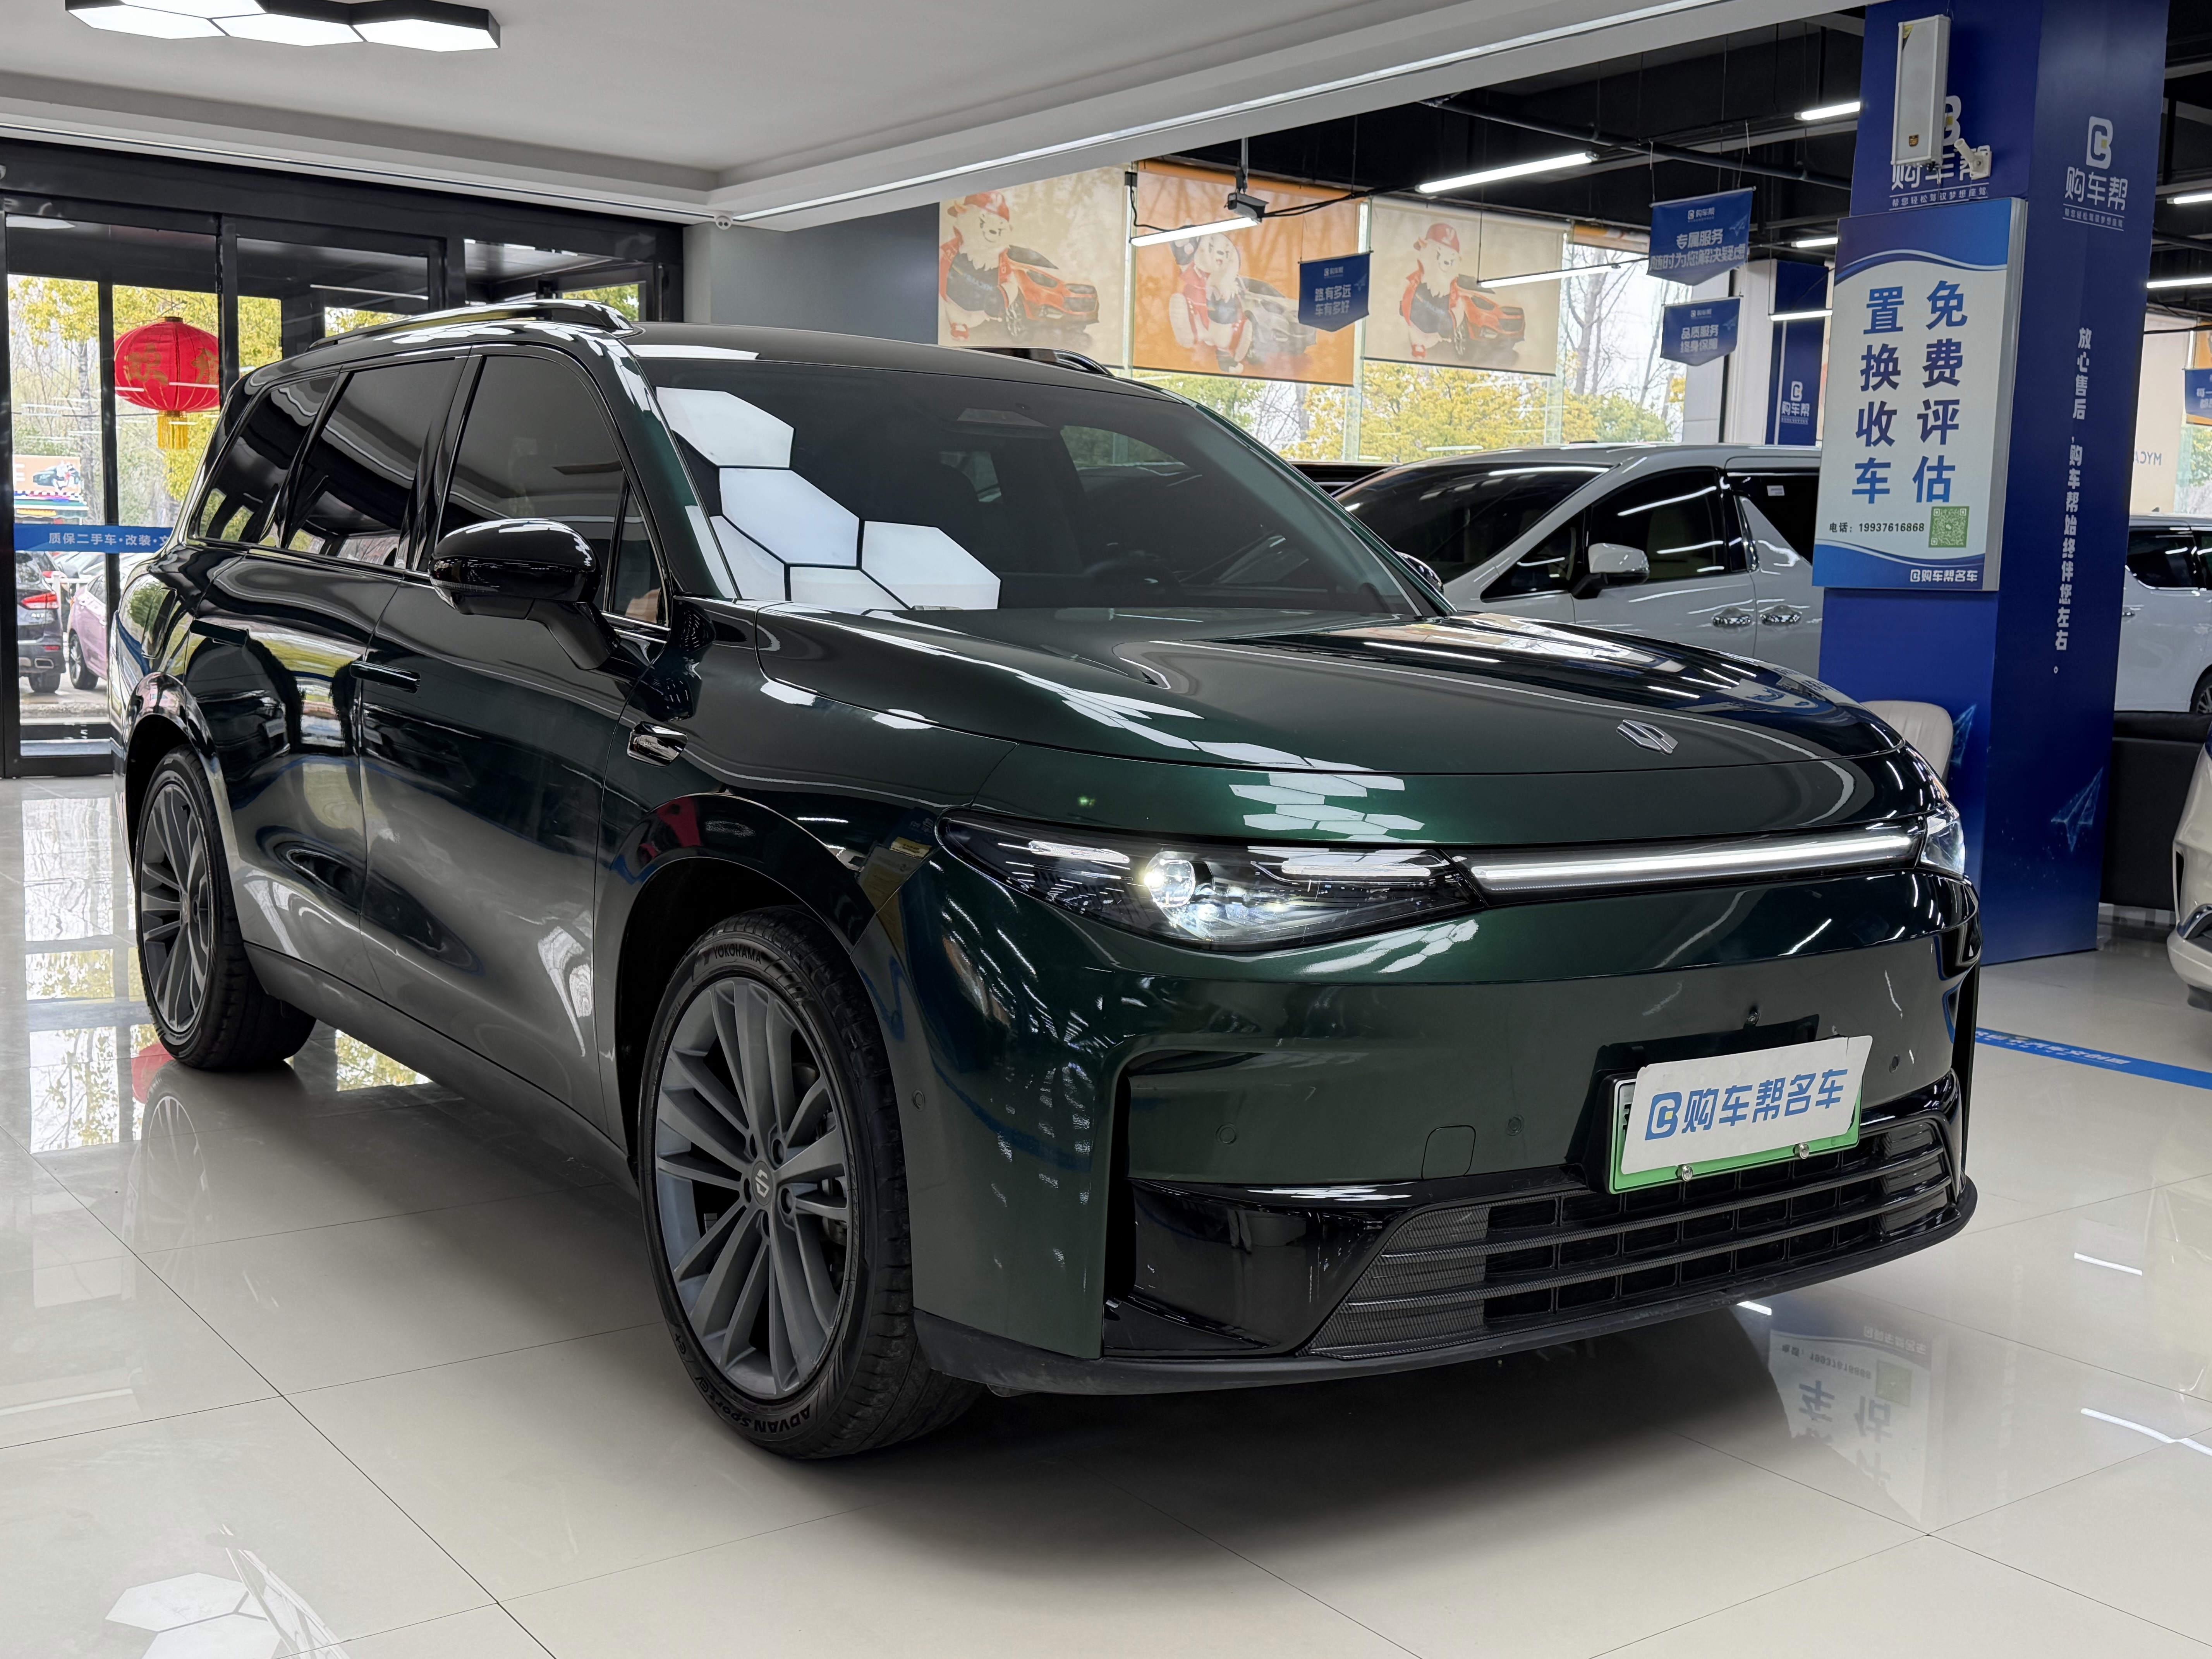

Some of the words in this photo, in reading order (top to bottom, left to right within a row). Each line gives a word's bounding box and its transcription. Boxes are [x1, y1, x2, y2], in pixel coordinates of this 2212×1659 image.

[2064, 166, 2128, 211] 购车帮
[1676, 228, 1723, 250] 专属服务
[1649, 243, 1746, 271] 随时为您解决疑虑
[1681, 325, 1719, 340] 品质服务
[1852, 285, 1905, 505] 置换收车
[1911, 280, 1968, 503] 免费评估
[1921, 569, 1978, 583] 购车帮名车
[713, 943, 762, 965] YOKOHAMA
[1681, 1068, 1848, 1134] 购车帮名车
[754, 1404, 811, 1433] ADVAN
